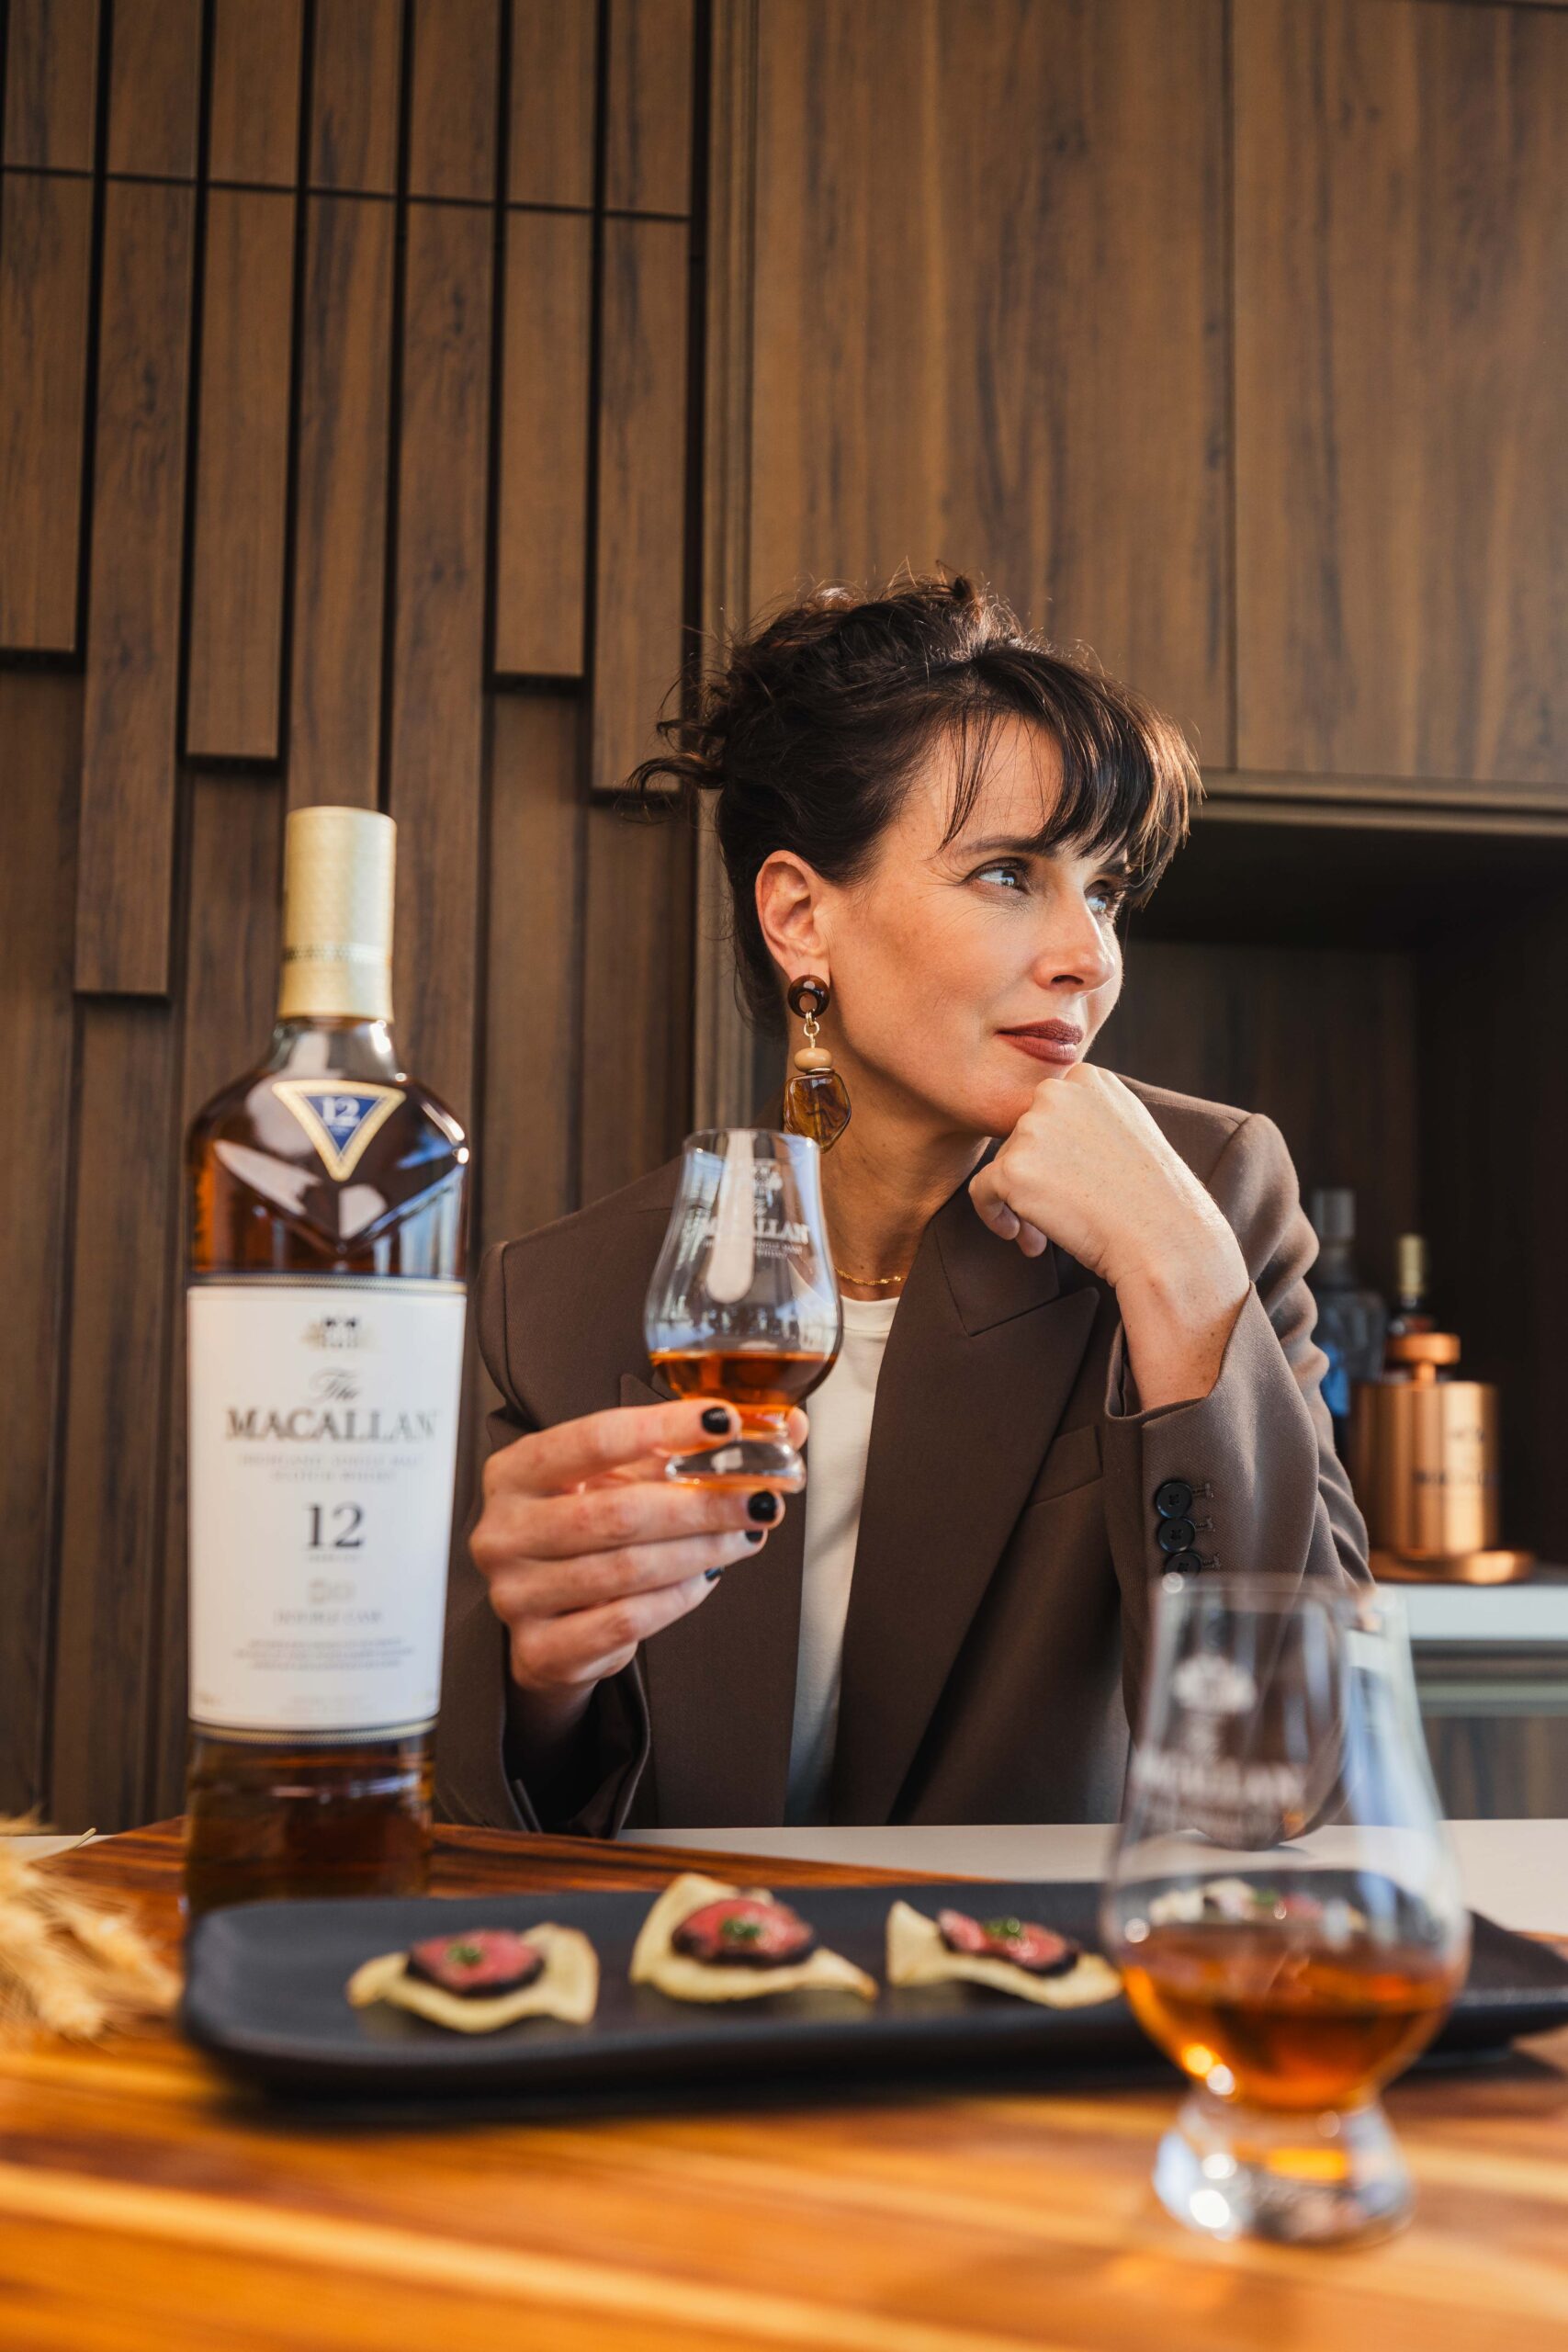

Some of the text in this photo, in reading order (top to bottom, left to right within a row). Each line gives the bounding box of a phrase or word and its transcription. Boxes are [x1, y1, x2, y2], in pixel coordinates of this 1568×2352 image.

[322, 1096, 361, 1127] 12
[309, 1366, 360, 1403] The
[226, 1406, 438, 1442] MACALLAN
[303, 1500, 366, 1550] 12
